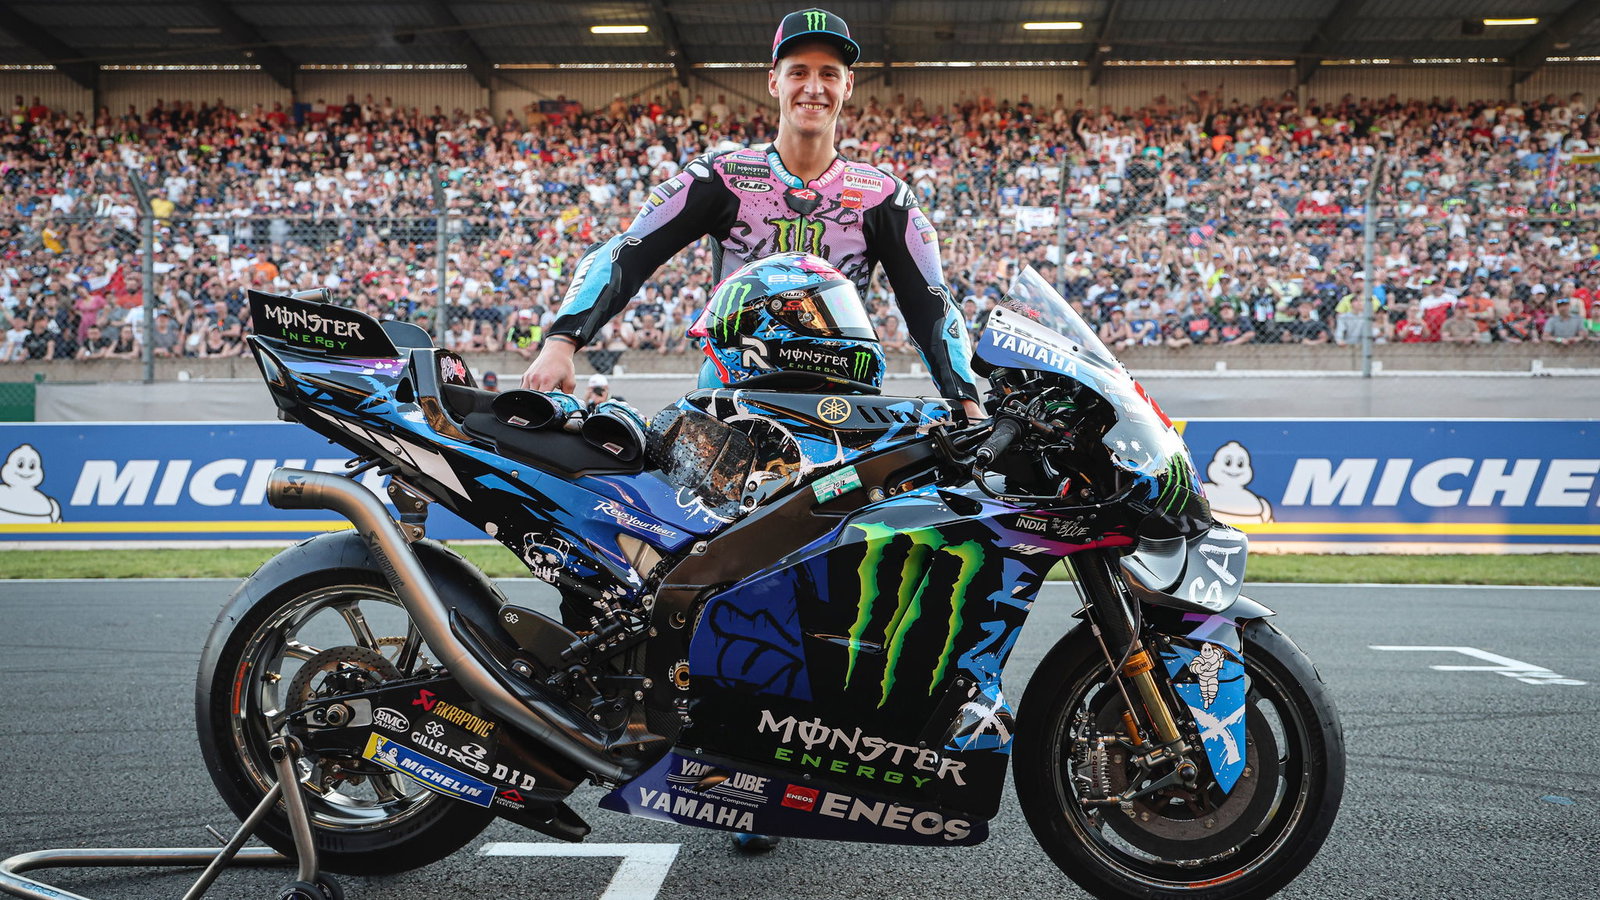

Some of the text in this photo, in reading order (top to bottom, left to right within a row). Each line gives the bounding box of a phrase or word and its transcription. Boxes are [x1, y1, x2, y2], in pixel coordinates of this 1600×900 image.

[769, 154, 796, 186] YAMAHA
[817, 161, 846, 188] YAMAHA
[853, 177, 882, 187] YAMAHA
[739, 182, 768, 190] HJC
[767, 274, 808, 283] BS
[991, 330, 1078, 377] YAMAHA
[1280, 458, 1600, 507] MICHE
[593, 499, 678, 537] Revs Your Heart
[1016, 518, 1047, 532] INDIA
[1056, 526, 1090, 537] BLUE
[376, 710, 407, 729] BMC
[411, 732, 448, 756] GILLES
[757, 710, 967, 786] MONSTER
[447, 748, 490, 774] RCB
[774, 747, 933, 789] ENERGY
[400, 757, 482, 798] MICHELIN
[639, 787, 754, 832] YAMAHA
[722, 796, 759, 809] Component
[786, 793, 813, 804] ENEOS
[819, 791, 971, 841] ENEOS
